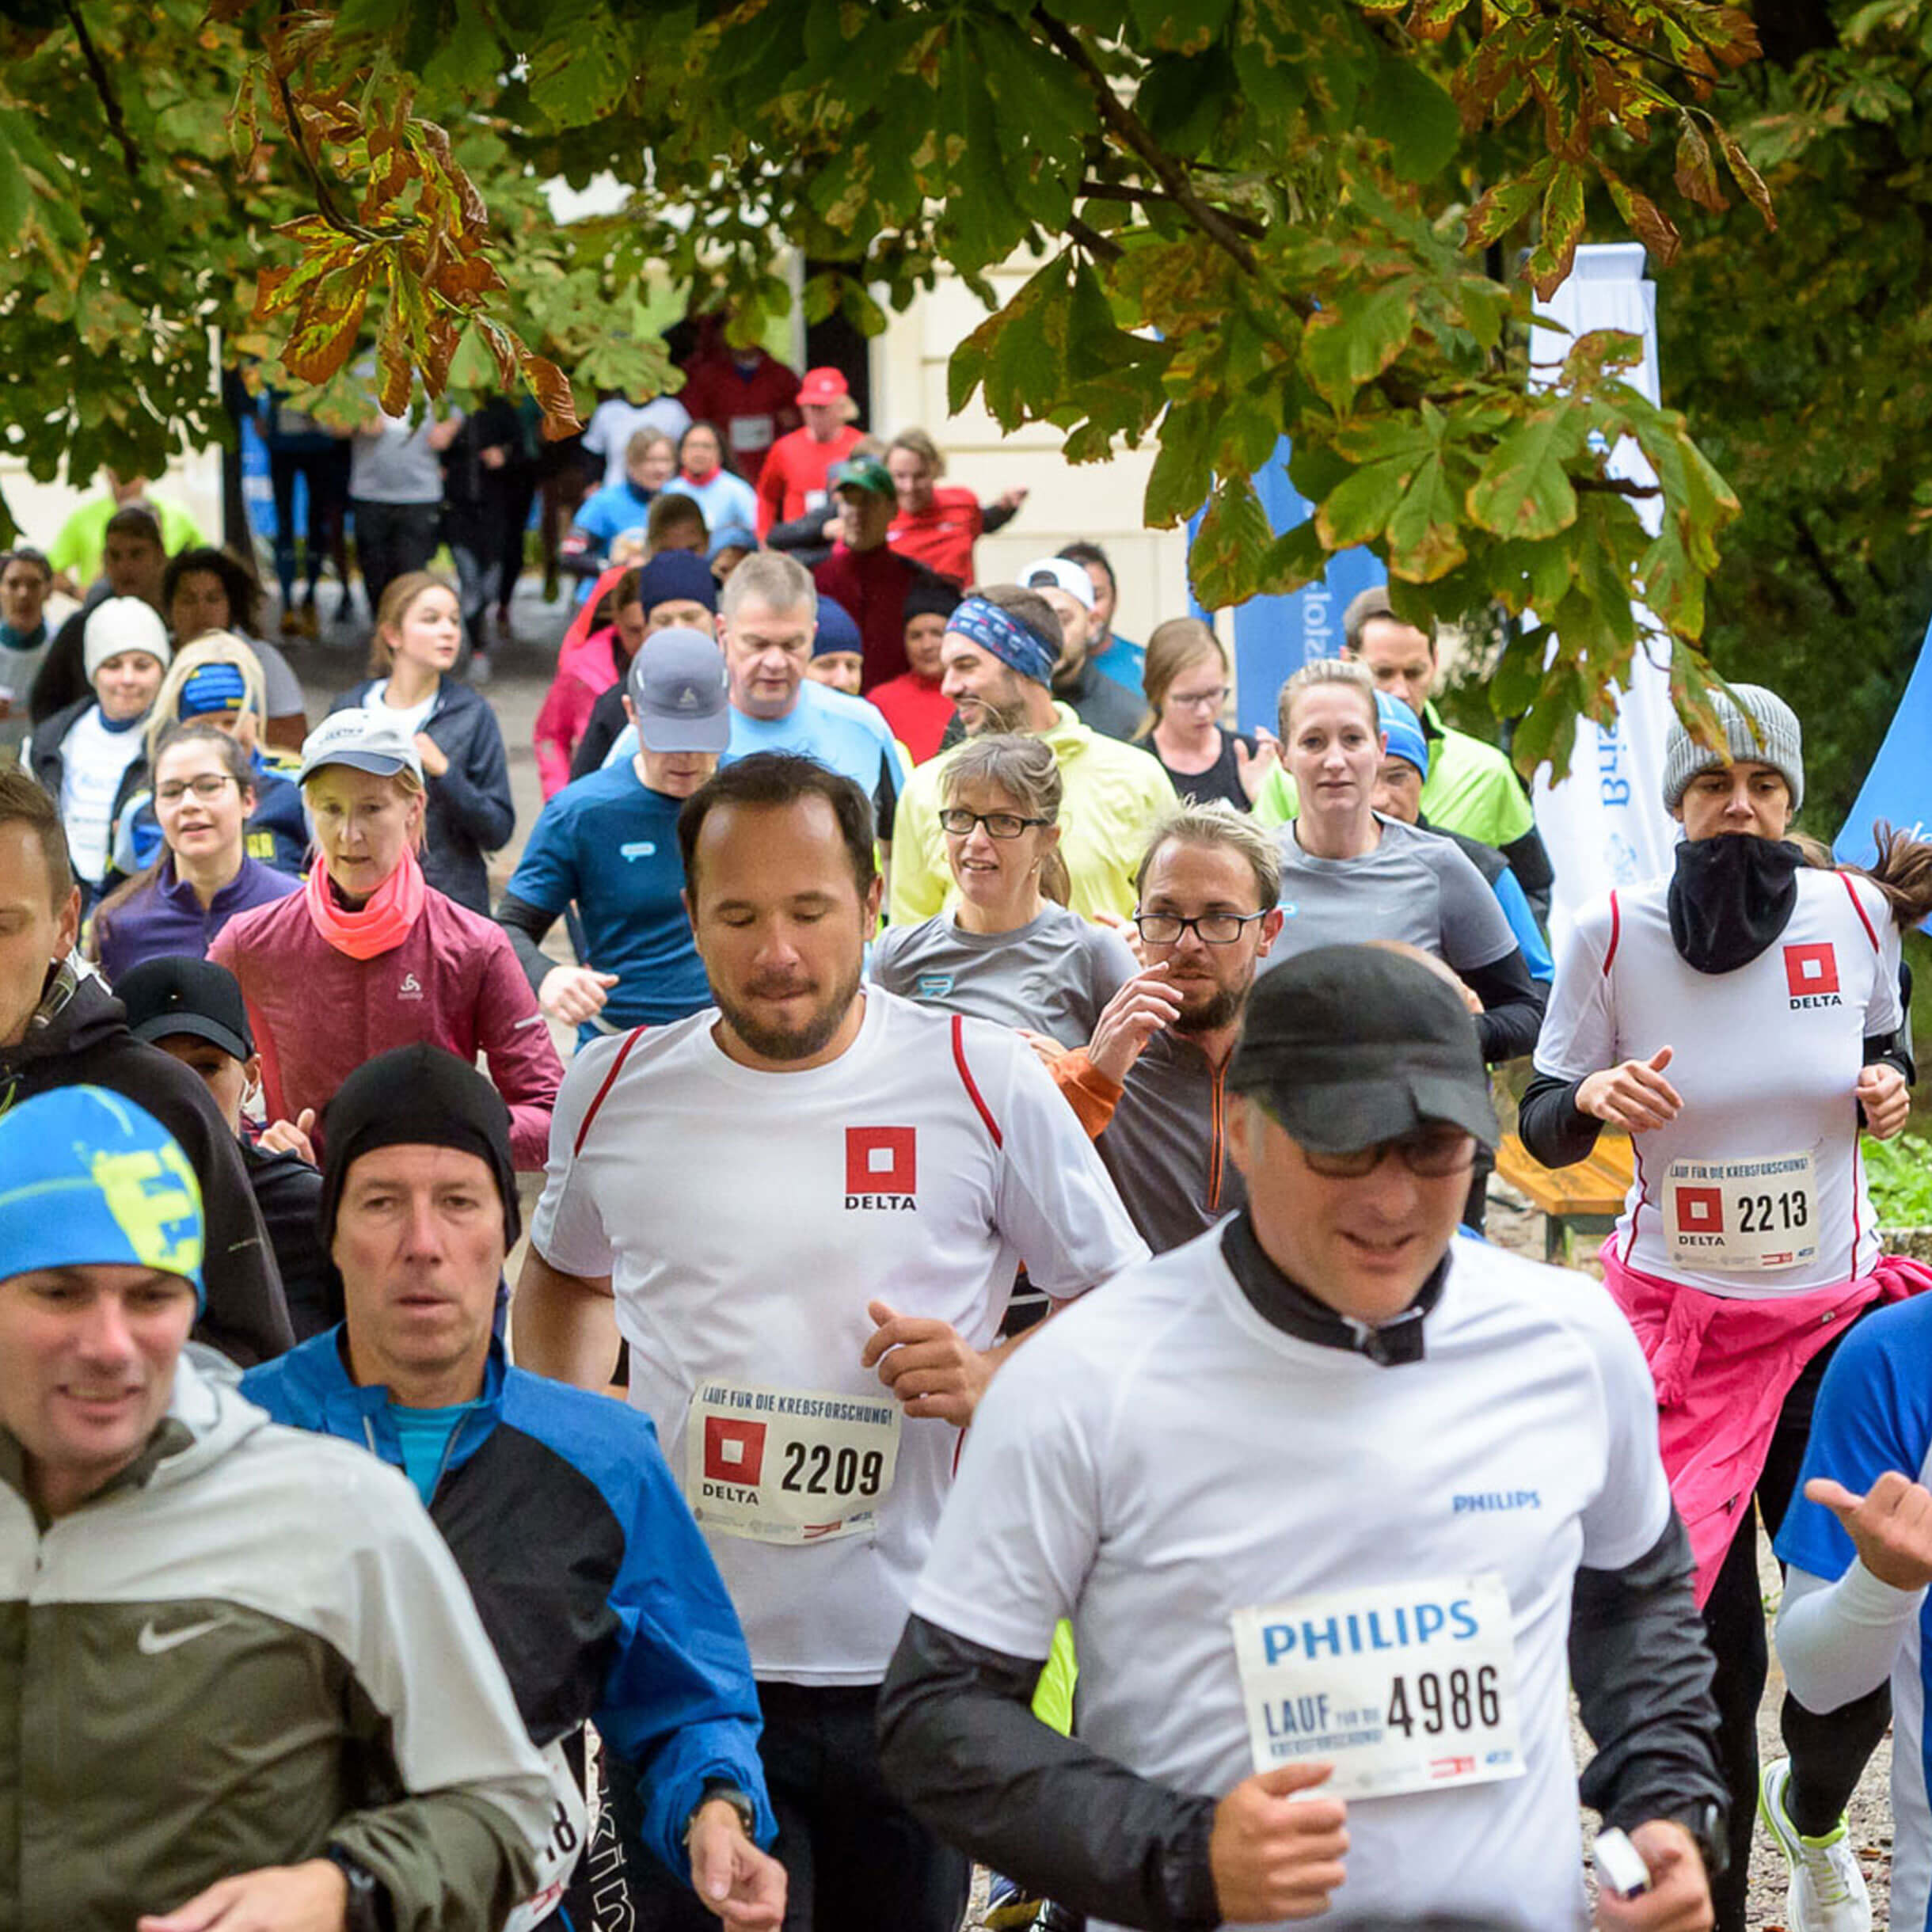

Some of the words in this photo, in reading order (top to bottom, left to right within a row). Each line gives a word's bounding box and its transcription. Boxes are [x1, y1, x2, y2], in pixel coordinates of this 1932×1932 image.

[1789, 995, 1843, 1010] DELTA
[1670, 1164, 1688, 1178] LAUF
[844, 1195, 916, 1211] DELTA
[1737, 1190, 1808, 1233] 2213
[1678, 1235, 1725, 1246] DELTA
[702, 1387, 727, 1405] LAUF
[730, 1391, 753, 1408] FÜR
[755, 1394, 775, 1411] DIE
[778, 1397, 893, 1426] KREBSFORSCHUNG!
[781, 1442, 884, 1496] 2209
[702, 1484, 759, 1505] DELTA
[1453, 1492, 1541, 1514] PHILIPS
[1263, 1599, 1479, 1666] PHILIPS
[1264, 1693, 1329, 1736] LAUF
[1387, 1665, 1500, 1737] 4986
[546, 1799, 577, 1862] 8
